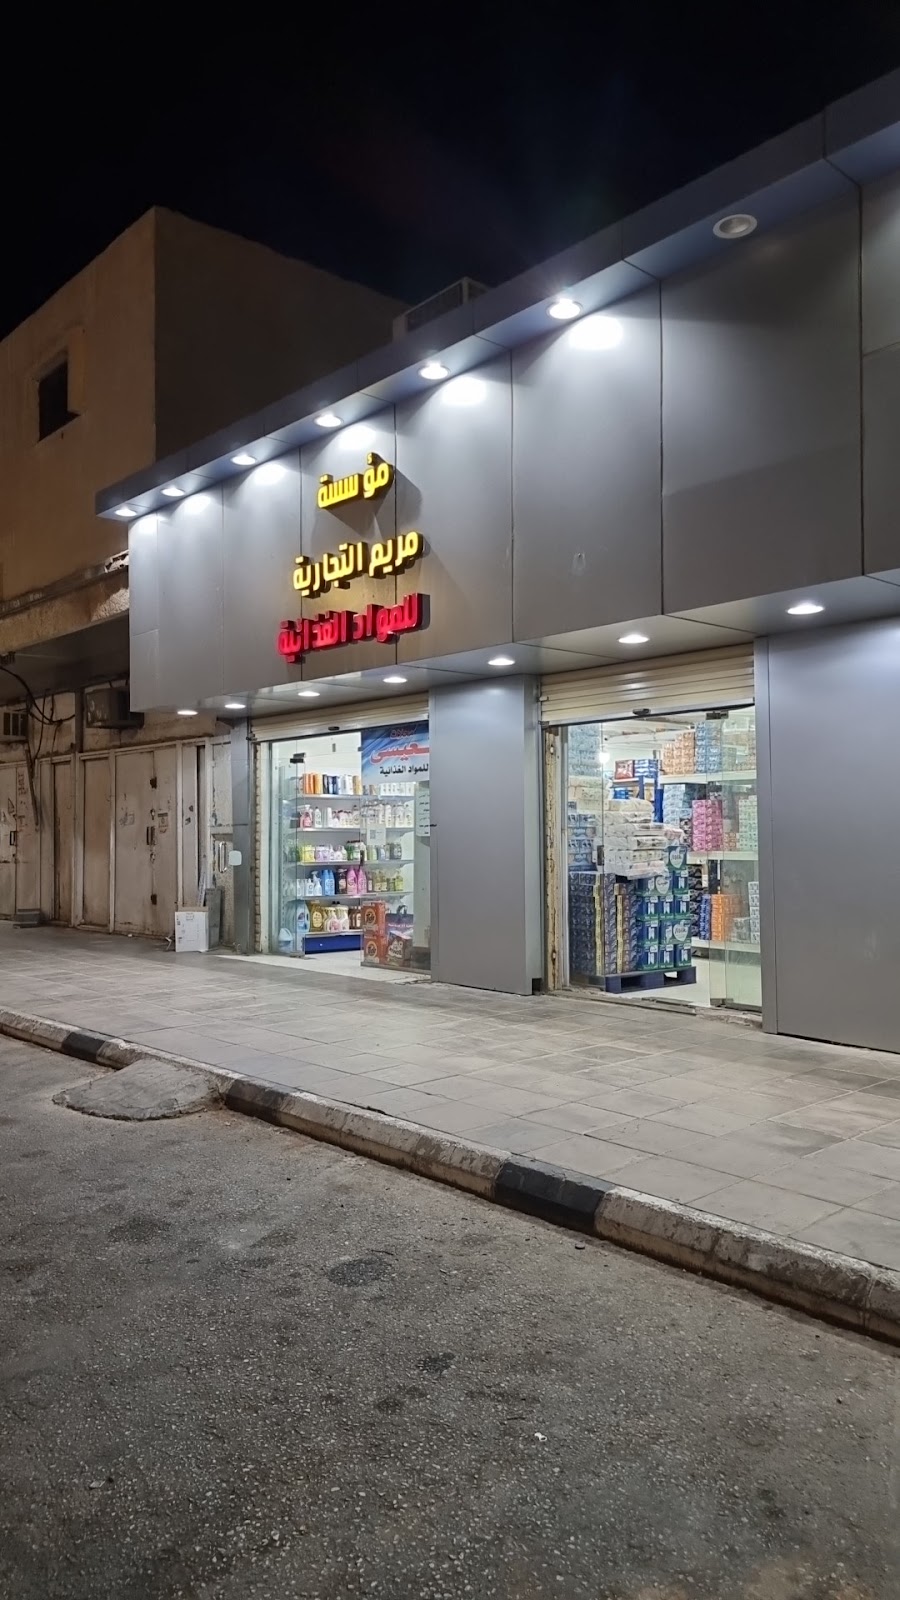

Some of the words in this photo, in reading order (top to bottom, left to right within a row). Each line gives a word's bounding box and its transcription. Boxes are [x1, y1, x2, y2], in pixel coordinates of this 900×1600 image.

[317, 452, 393, 509] مؤسسة
[292, 541, 367, 597] التجارية
[368, 531, 422, 578] مريم
[277, 610, 351, 663] الغذائية
[352, 592, 424, 643] للمواد
